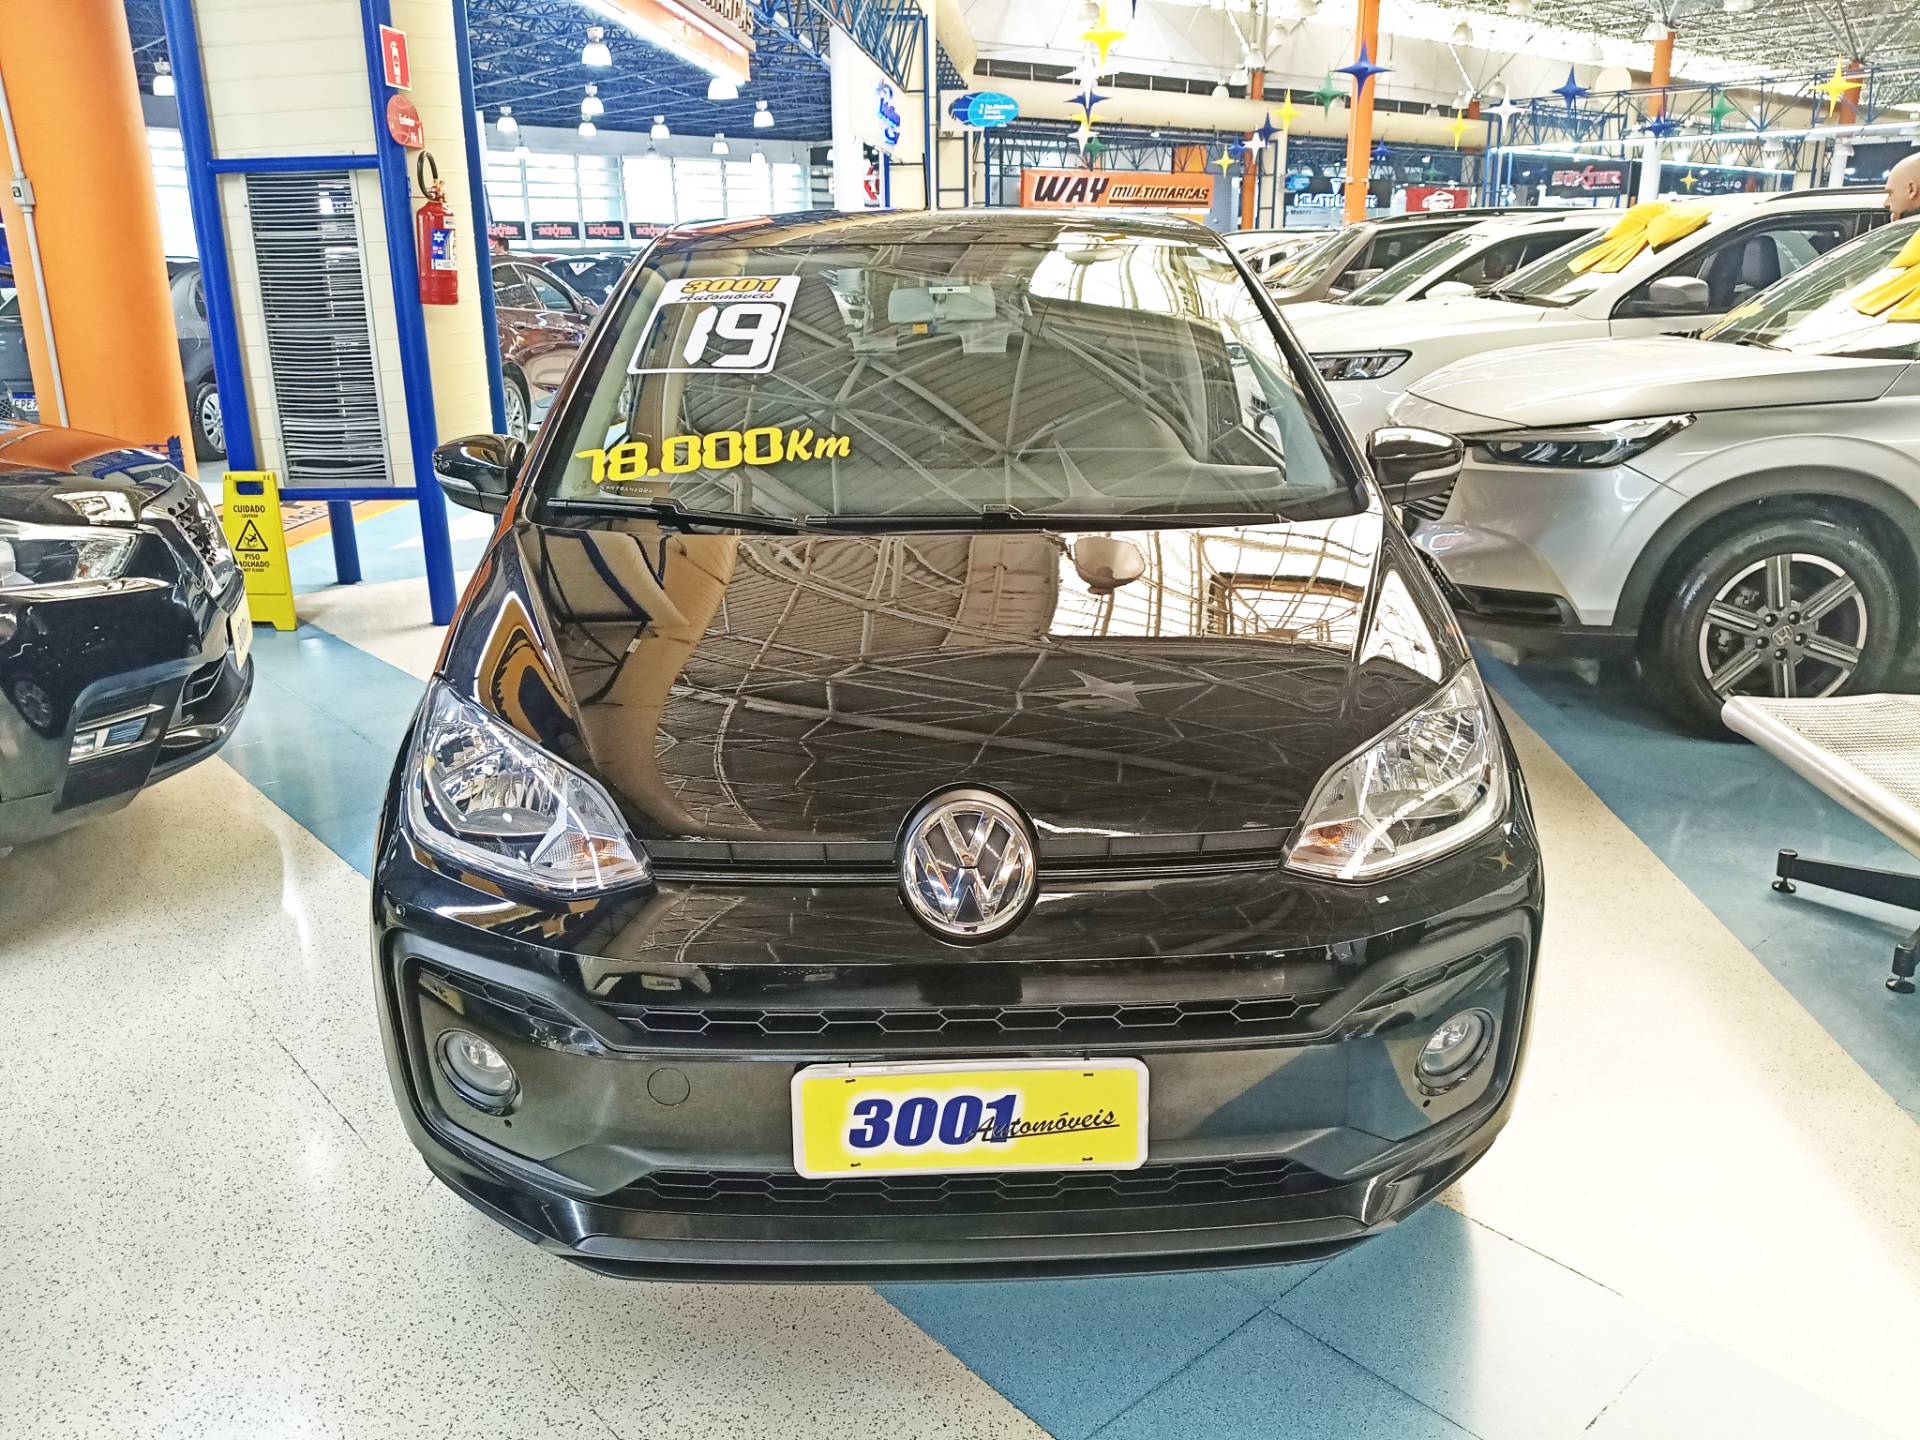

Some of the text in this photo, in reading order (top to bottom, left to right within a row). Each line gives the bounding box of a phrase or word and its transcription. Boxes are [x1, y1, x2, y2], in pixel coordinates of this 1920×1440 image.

[1033, 175, 1209, 203] WAY MULTIMARCAS
[681, 278, 781, 293] 3001
[682, 304, 782, 367] 19
[233, 504, 266, 513] CUIDADO
[849, 1094, 1117, 1148] 3001 Automóveis
